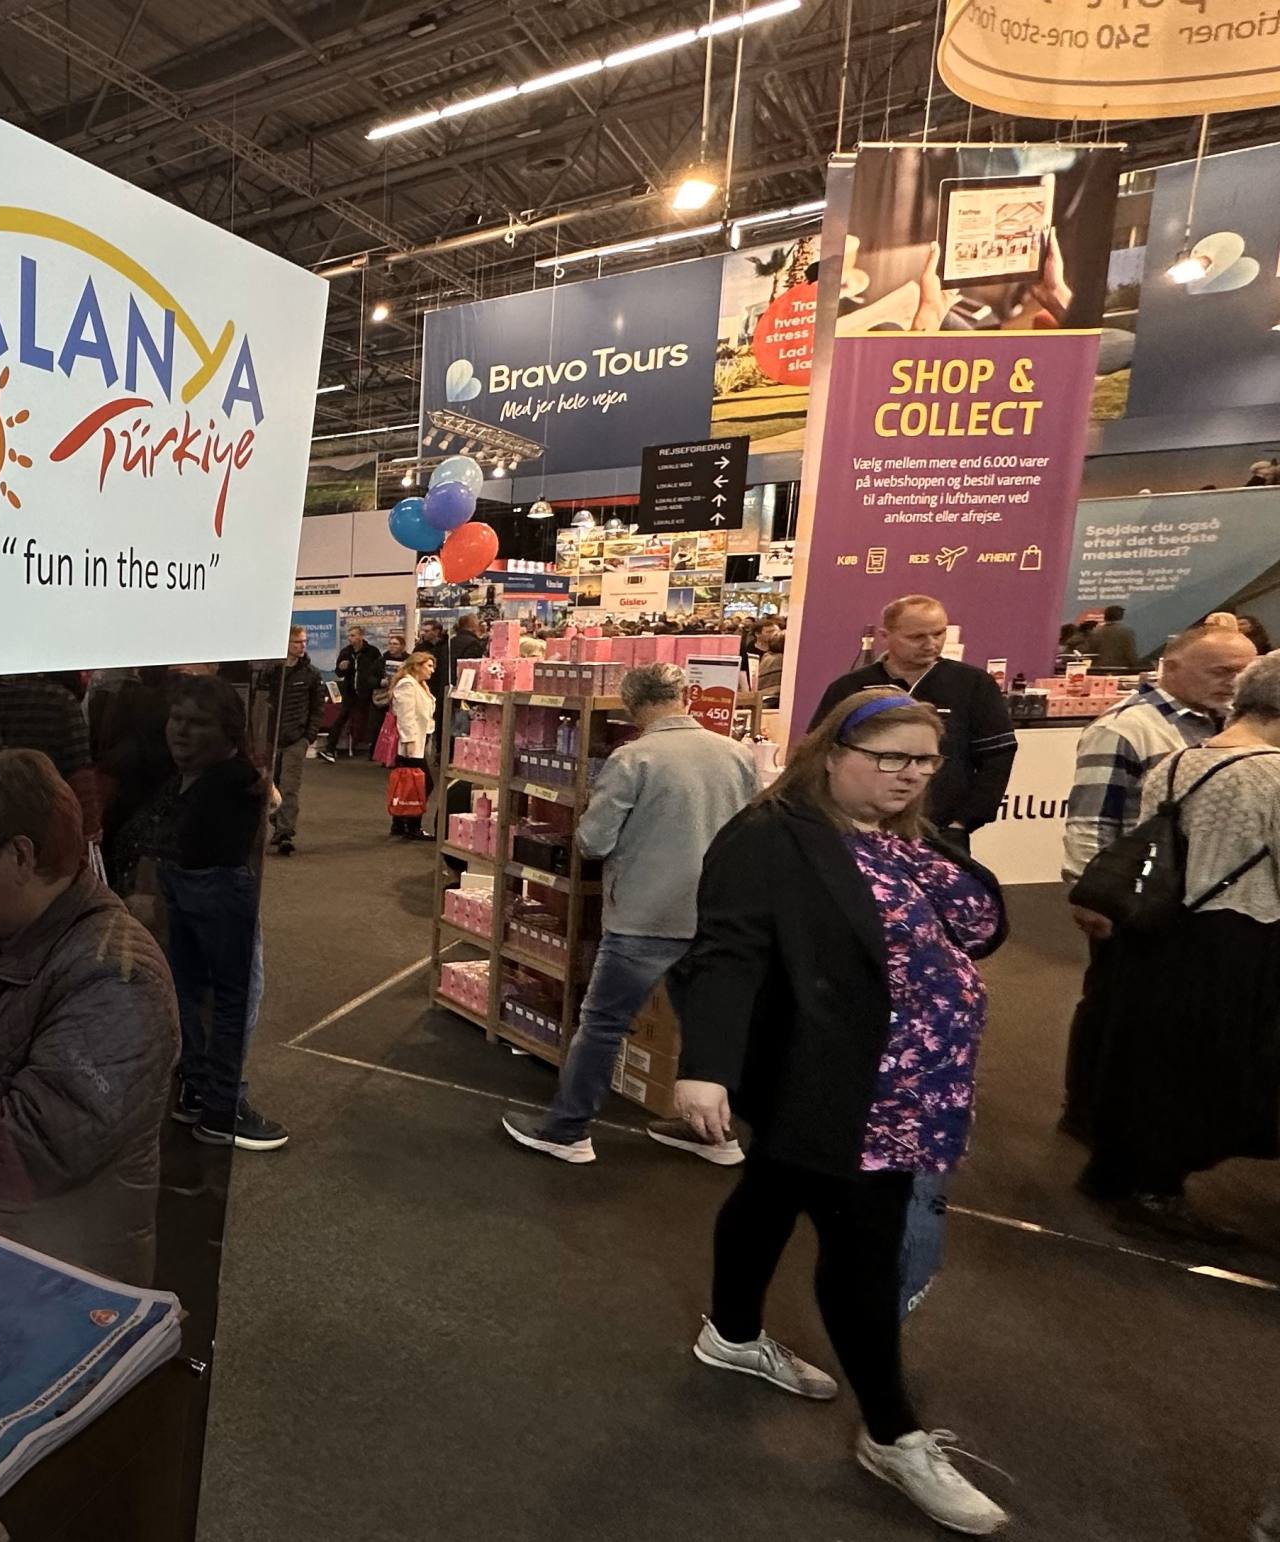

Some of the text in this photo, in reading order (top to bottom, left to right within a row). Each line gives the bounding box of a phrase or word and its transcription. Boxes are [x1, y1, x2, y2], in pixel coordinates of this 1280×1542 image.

[779, 345, 807, 359] Lad
[489, 343, 689, 393] Bravo Tours
[889, 358, 1035, 394] SHOP &
[499, 390, 627, 423] Med jer hele vejen
[875, 401, 1042, 437] COLLECT
[659, 442, 732, 456] REJSEFOREDRAG
[50, 397, 255, 538] Türkiye
[853, 456, 1049, 472] Vælg mellem mere end 6.000 varer
[856, 474, 1041, 490] på webshoppen og bestil varerne
[864, 491, 1029, 508] til afhentning i lufthavnen ved
[884, 510, 1003, 525] ankomst eller afrejse.
[1085, 518, 1220, 537] Spejder du også
[1083, 533, 1218, 548] efter det bedste
[836, 555, 858, 566] KØB
[977, 552, 1016, 563] AFHENT
[1082, 545, 1190, 560] messetilbud?
[85, 549, 107, 588] in
[117, 547, 159, 590] the
[619, 597, 648, 607] Gislev
[706, 708, 730, 720] 450
